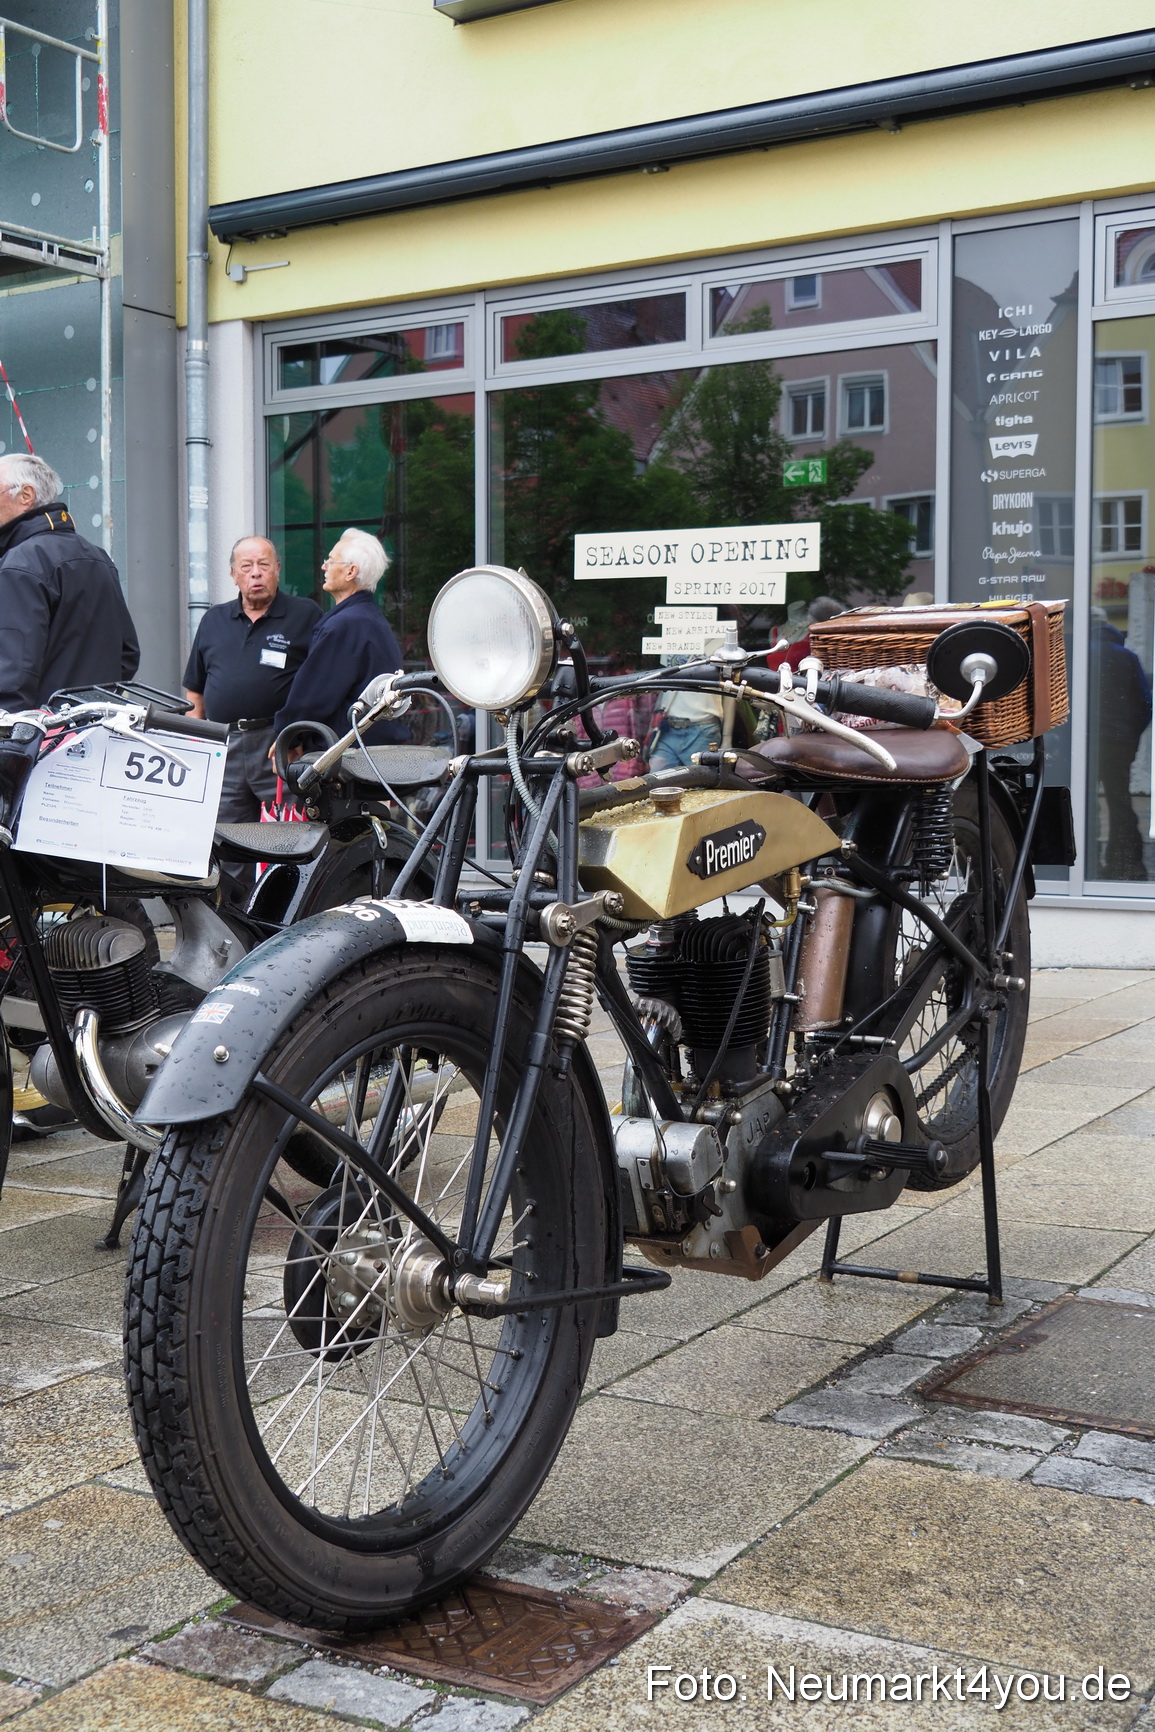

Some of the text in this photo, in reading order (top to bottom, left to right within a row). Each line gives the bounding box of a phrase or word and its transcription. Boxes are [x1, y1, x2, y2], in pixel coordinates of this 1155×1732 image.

[998, 304, 1033, 319] ICHI
[978, 323, 1053, 341] KEY LARGO
[988, 346, 1042, 362] VILA
[999, 369, 1044, 381] GANG
[988, 390, 1040, 406] APRICOT
[994, 414, 1033, 427] tigha
[999, 467, 1047, 480] SUPERGA
[992, 492, 1034, 511] DRYKORN
[992, 520, 1033, 538] khujo
[585, 537, 810, 567] SEASON OPENING
[981, 546, 1042, 564] Pepe Jeans
[978, 574, 1046, 585] G-STAR RAW
[674, 581, 777, 598] SPRING 2017
[658, 612, 675, 620] NEW
[678, 611, 713, 620] STYLES
[665, 627, 682, 636] NEW
[645, 642, 701, 651] NEW BRANDS
[124, 751, 187, 788] 520
[705, 834, 756, 875] Premier
[746, 1111, 770, 1144] JAP
